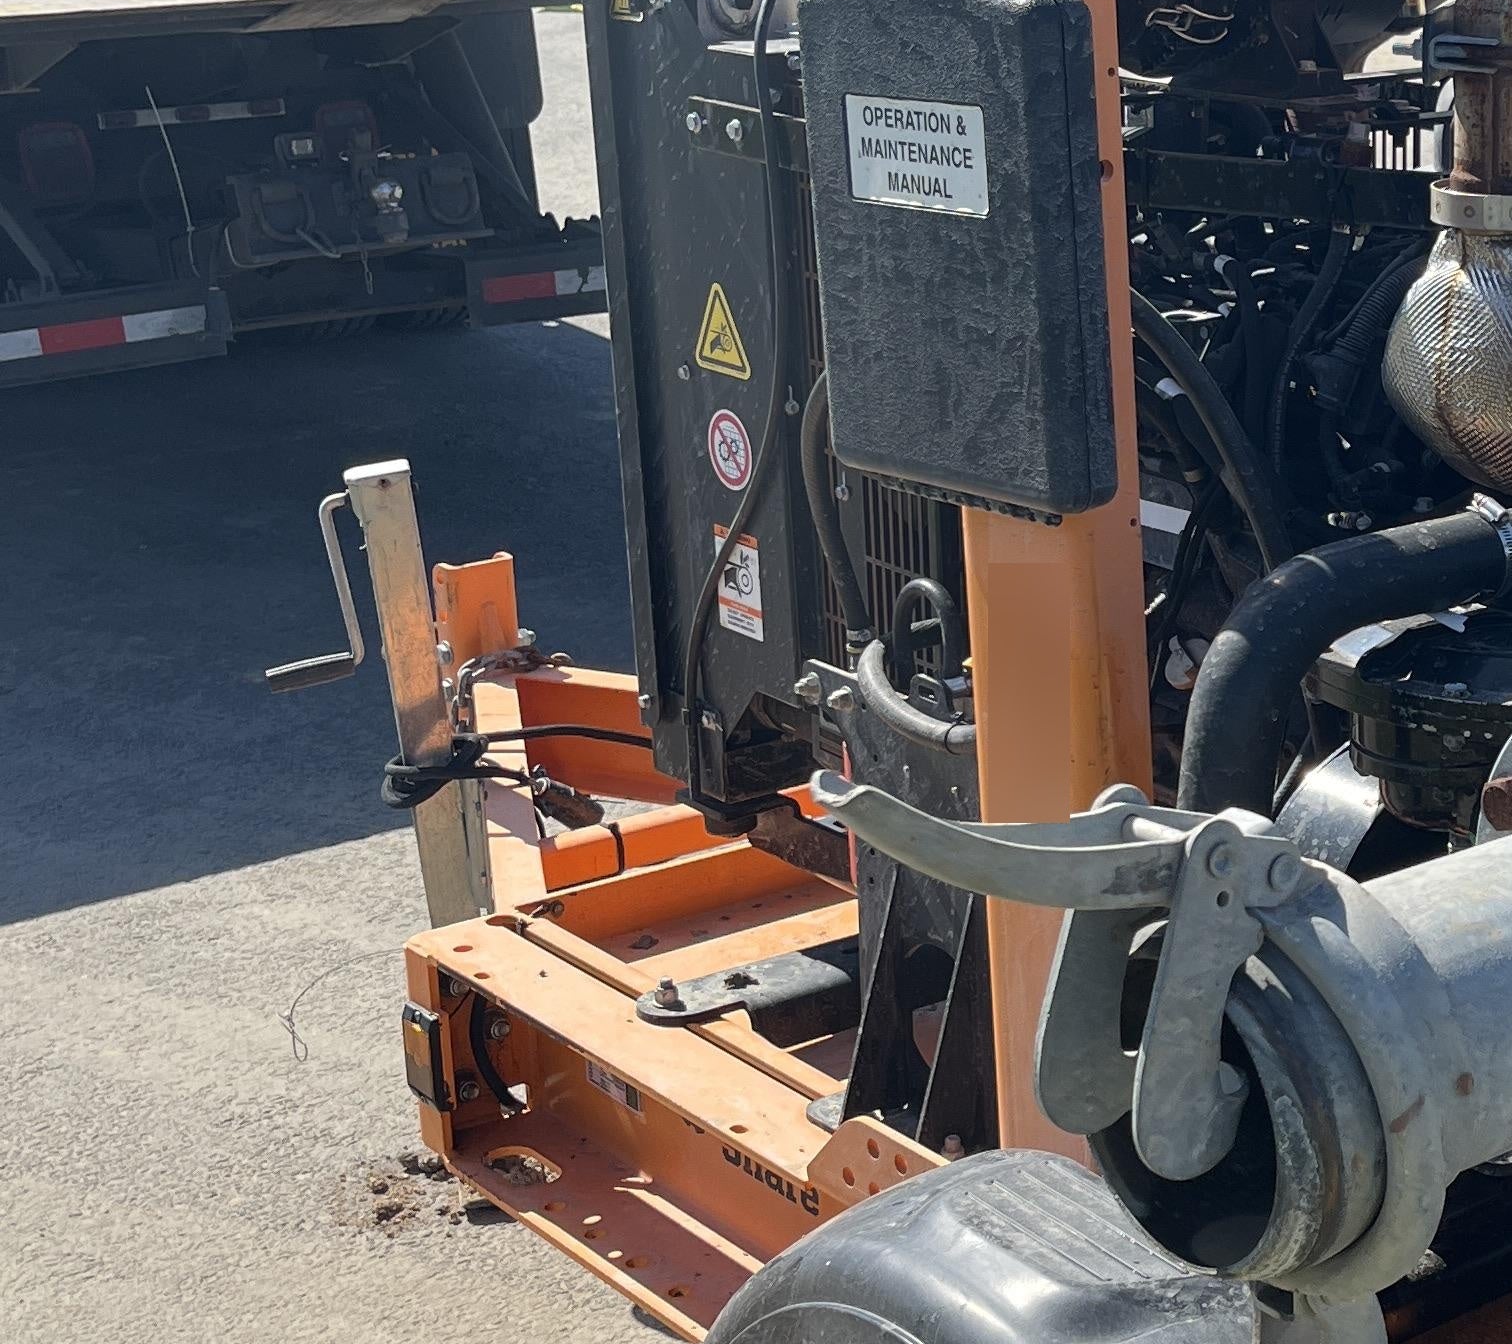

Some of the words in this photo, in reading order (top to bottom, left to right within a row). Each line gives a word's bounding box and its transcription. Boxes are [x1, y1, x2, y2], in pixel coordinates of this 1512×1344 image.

[863, 105, 951, 135] OPERATION
[956, 114, 967, 136] &
[861, 136, 973, 170] MAINTENANCE
[888, 171, 953, 199] MANUAL
